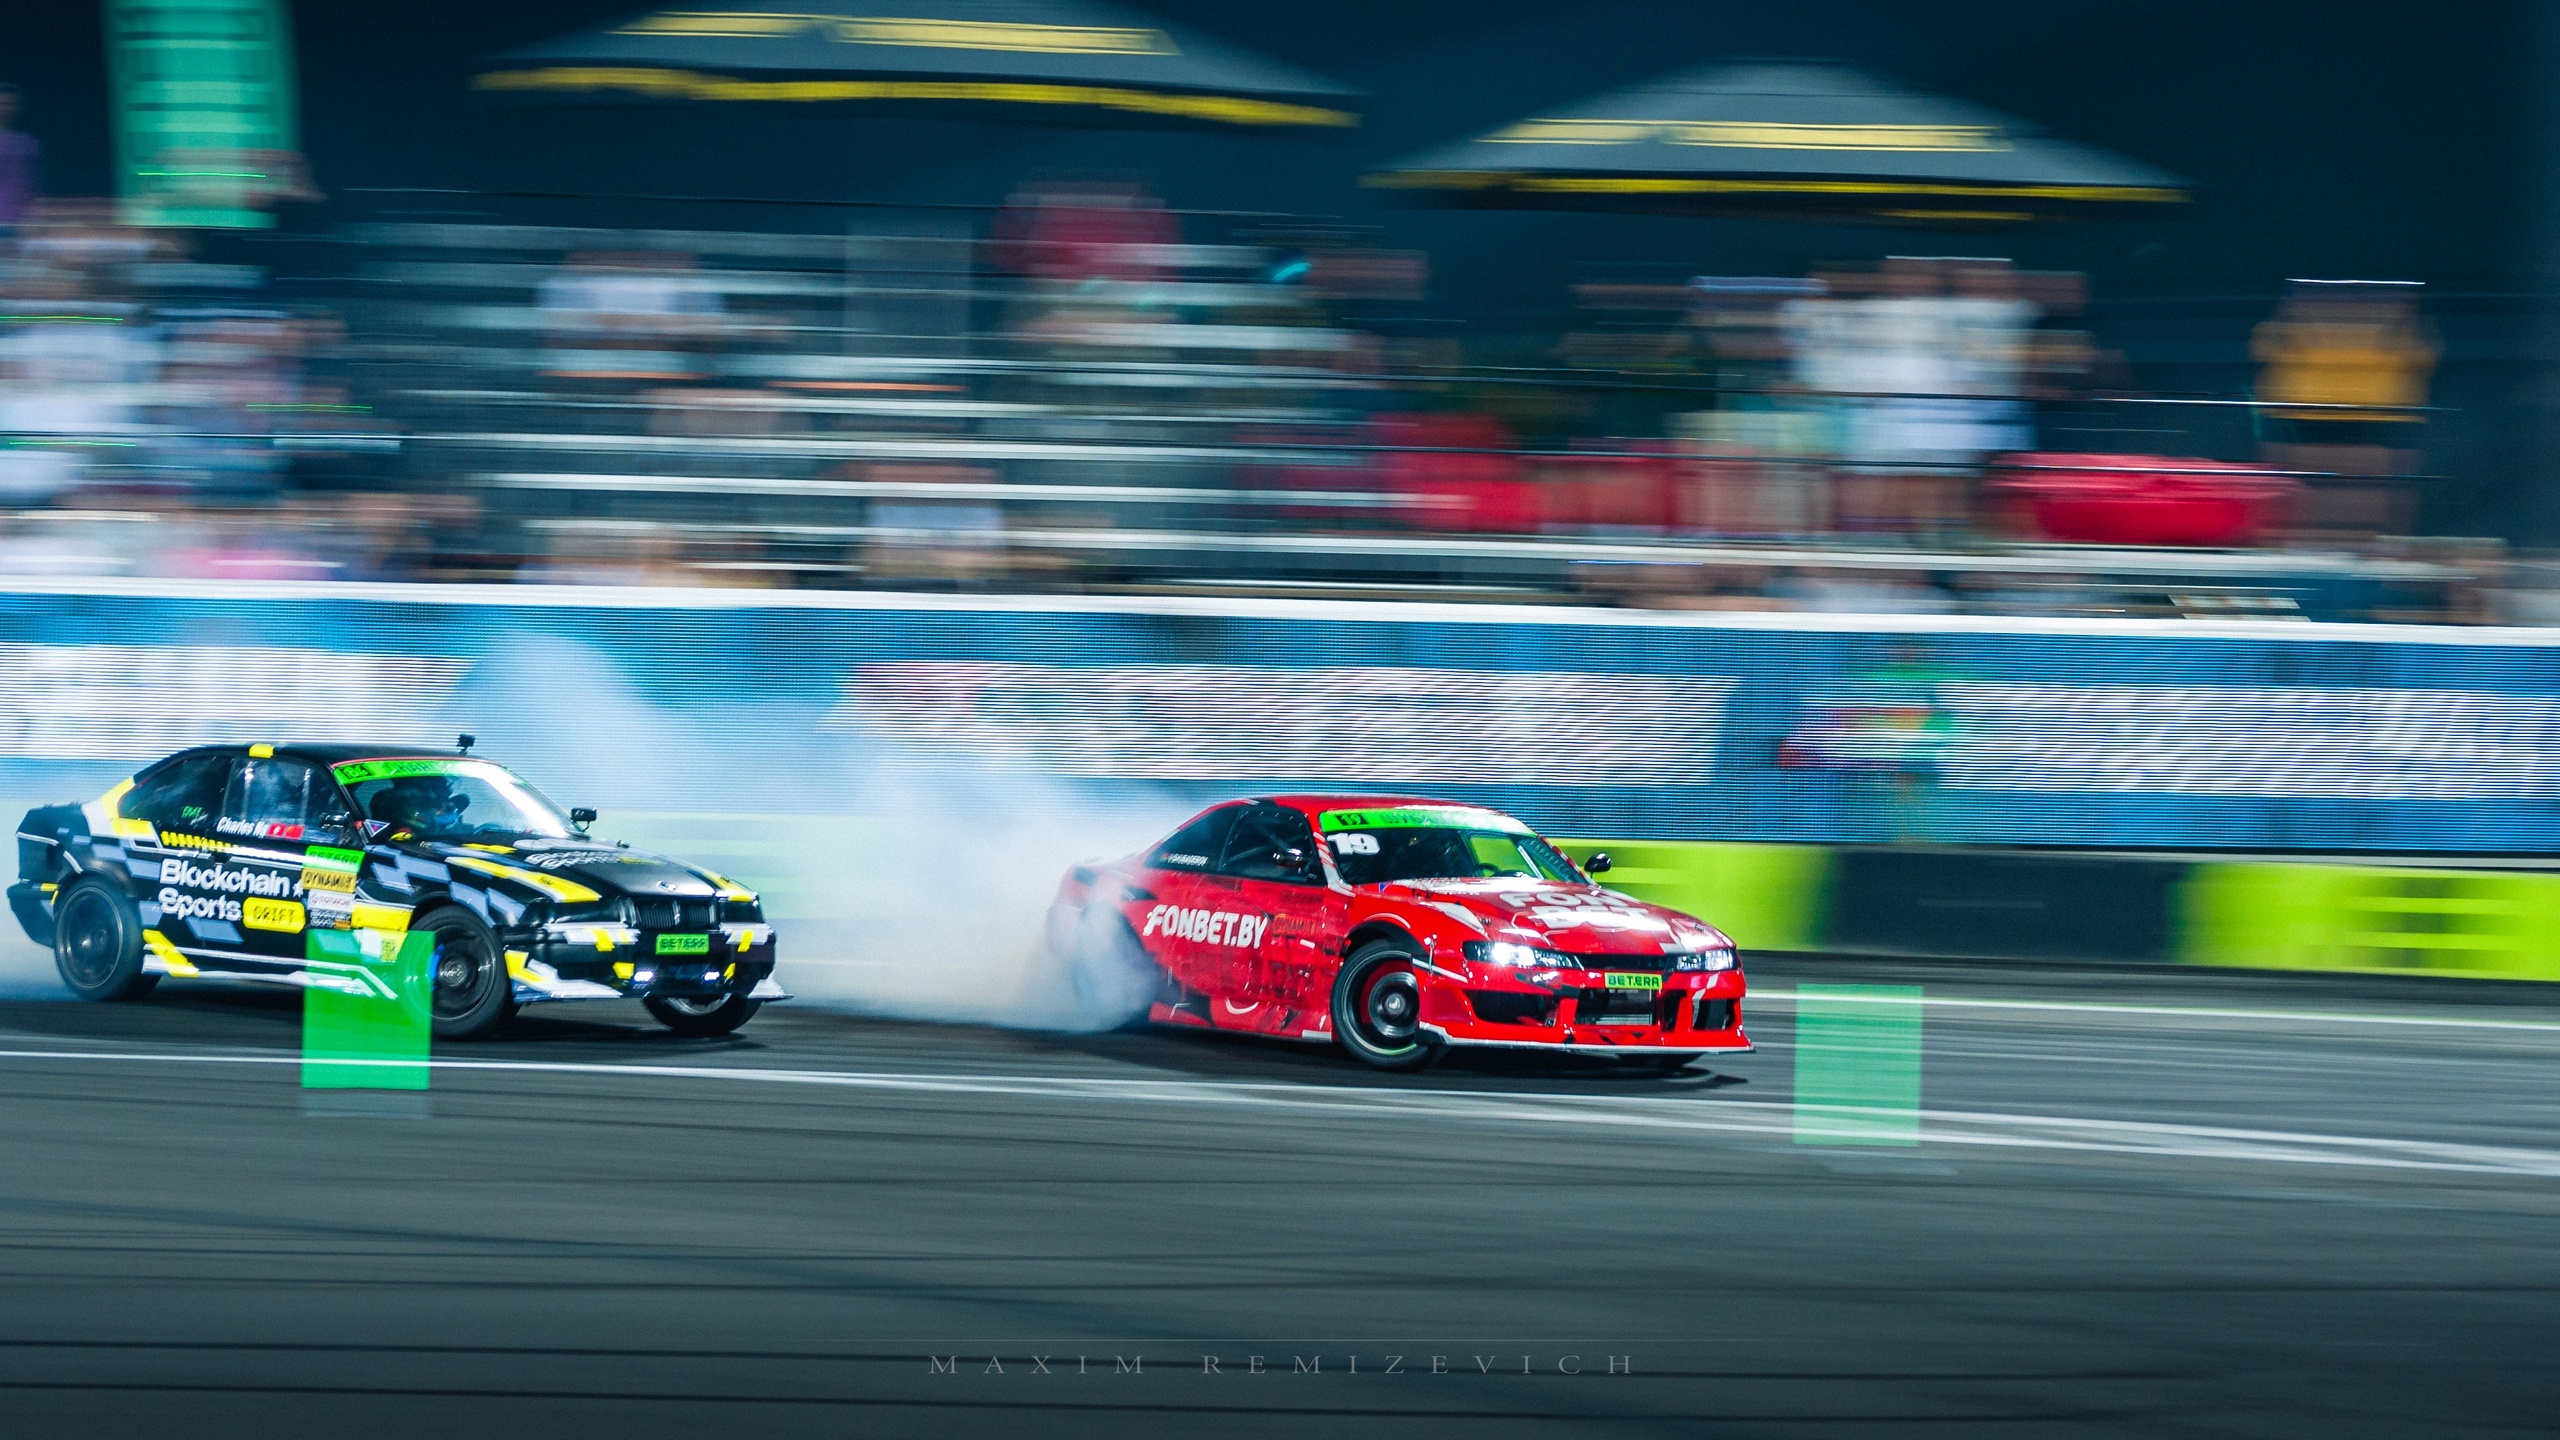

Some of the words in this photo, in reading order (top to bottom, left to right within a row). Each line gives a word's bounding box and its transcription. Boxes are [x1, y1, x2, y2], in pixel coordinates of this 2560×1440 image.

[216, 816, 255, 835] Charles
[1340, 813, 1362, 826] 19
[1326, 832, 1381, 856] 19
[159, 858, 291, 898] Blockchain
[158, 887, 243, 921] Sports
[1499, 891, 1628, 908] FON
[252, 905, 296, 926] DRIFT
[1142, 903, 1269, 950] FONBET.BY
